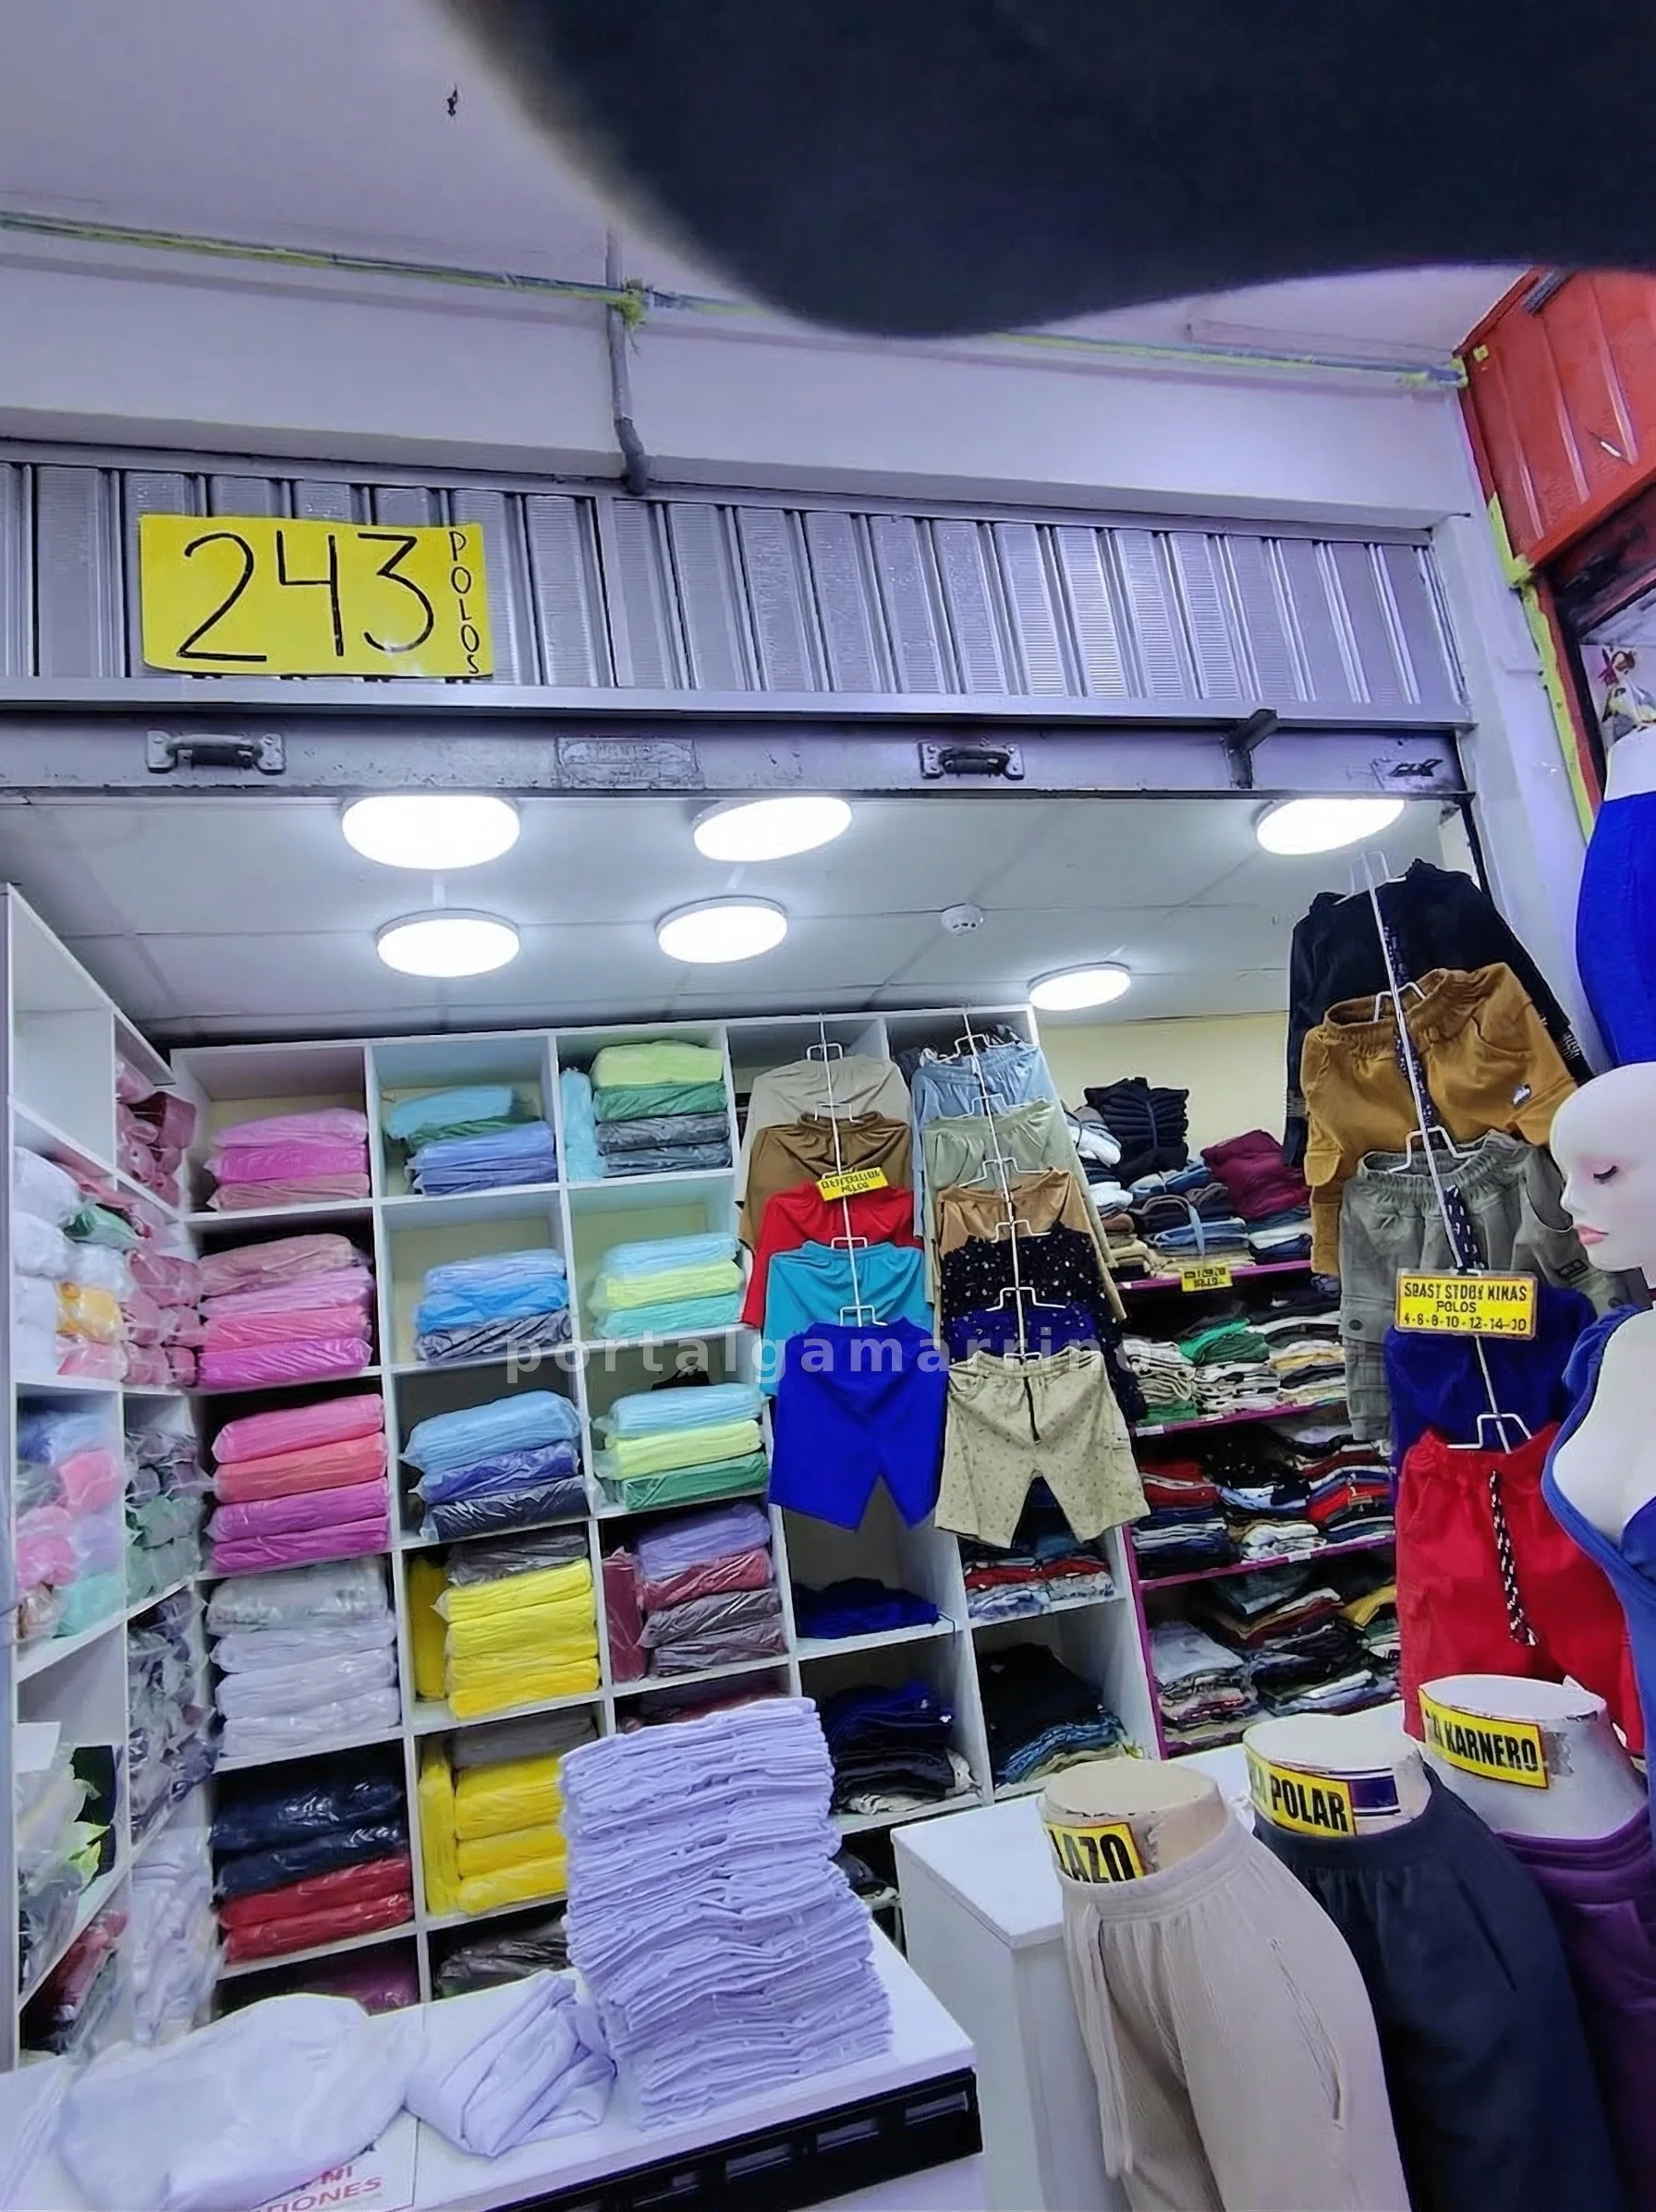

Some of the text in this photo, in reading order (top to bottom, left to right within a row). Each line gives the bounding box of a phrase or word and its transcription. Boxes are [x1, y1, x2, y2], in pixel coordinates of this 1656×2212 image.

[177, 529, 434, 662] 243
[448, 530, 481, 675] POLOS
[1443, 1720, 1540, 1773] KARNERO
[1269, 1773, 1349, 1833] POLAR
